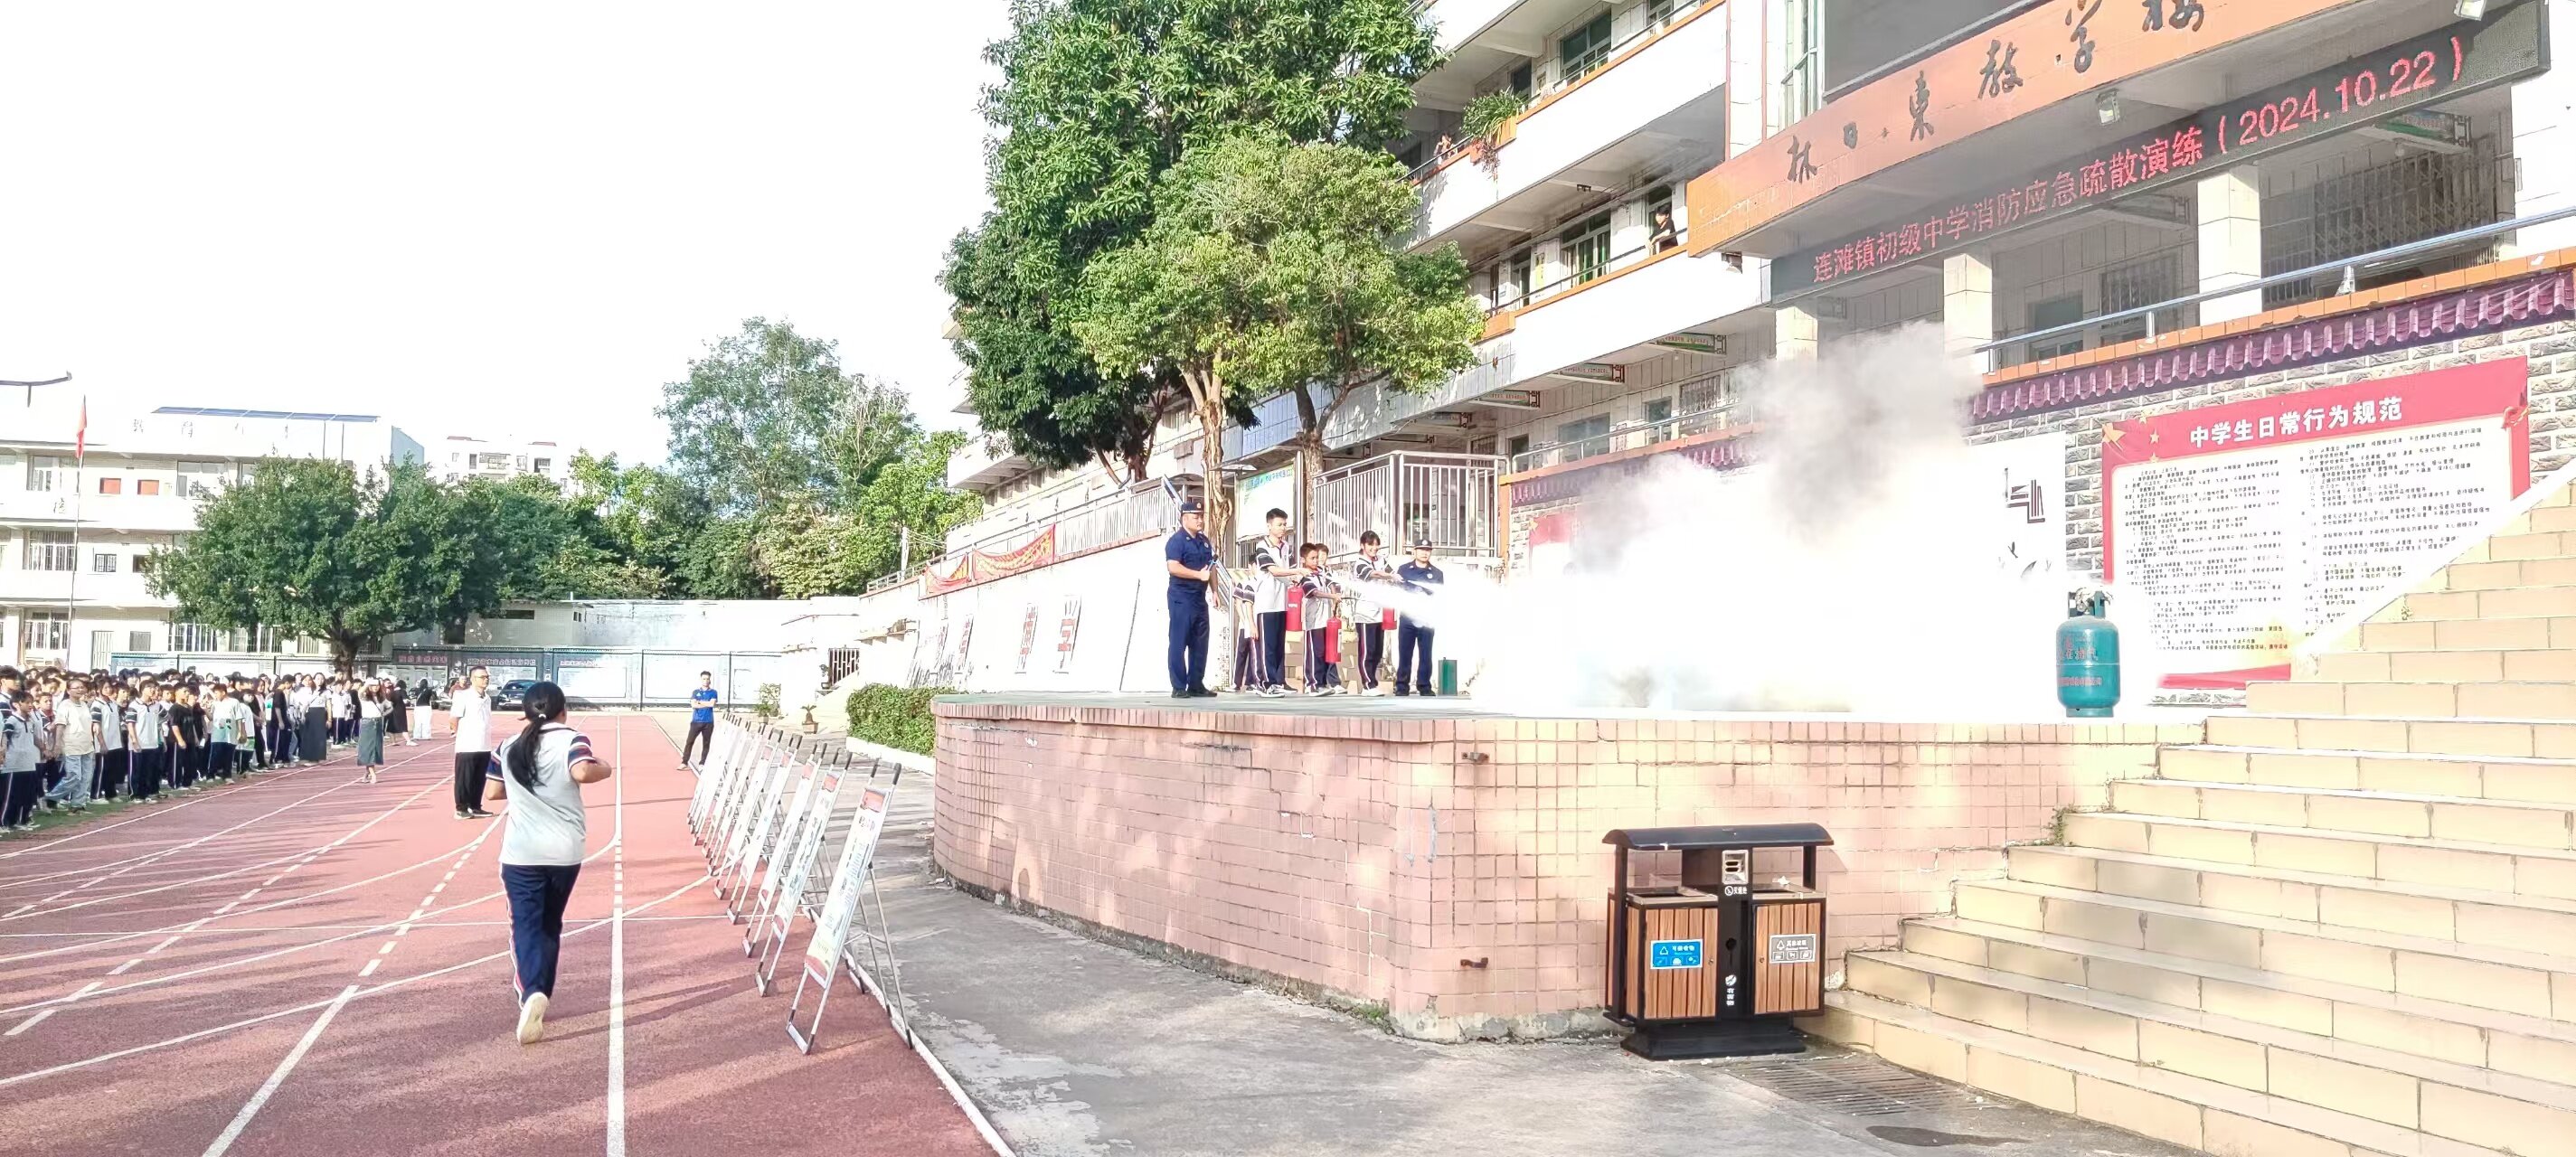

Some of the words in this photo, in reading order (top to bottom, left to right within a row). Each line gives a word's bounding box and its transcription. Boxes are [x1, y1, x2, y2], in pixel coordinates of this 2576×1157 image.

[2189, 396, 2402, 449] 中学生日常行为规范
